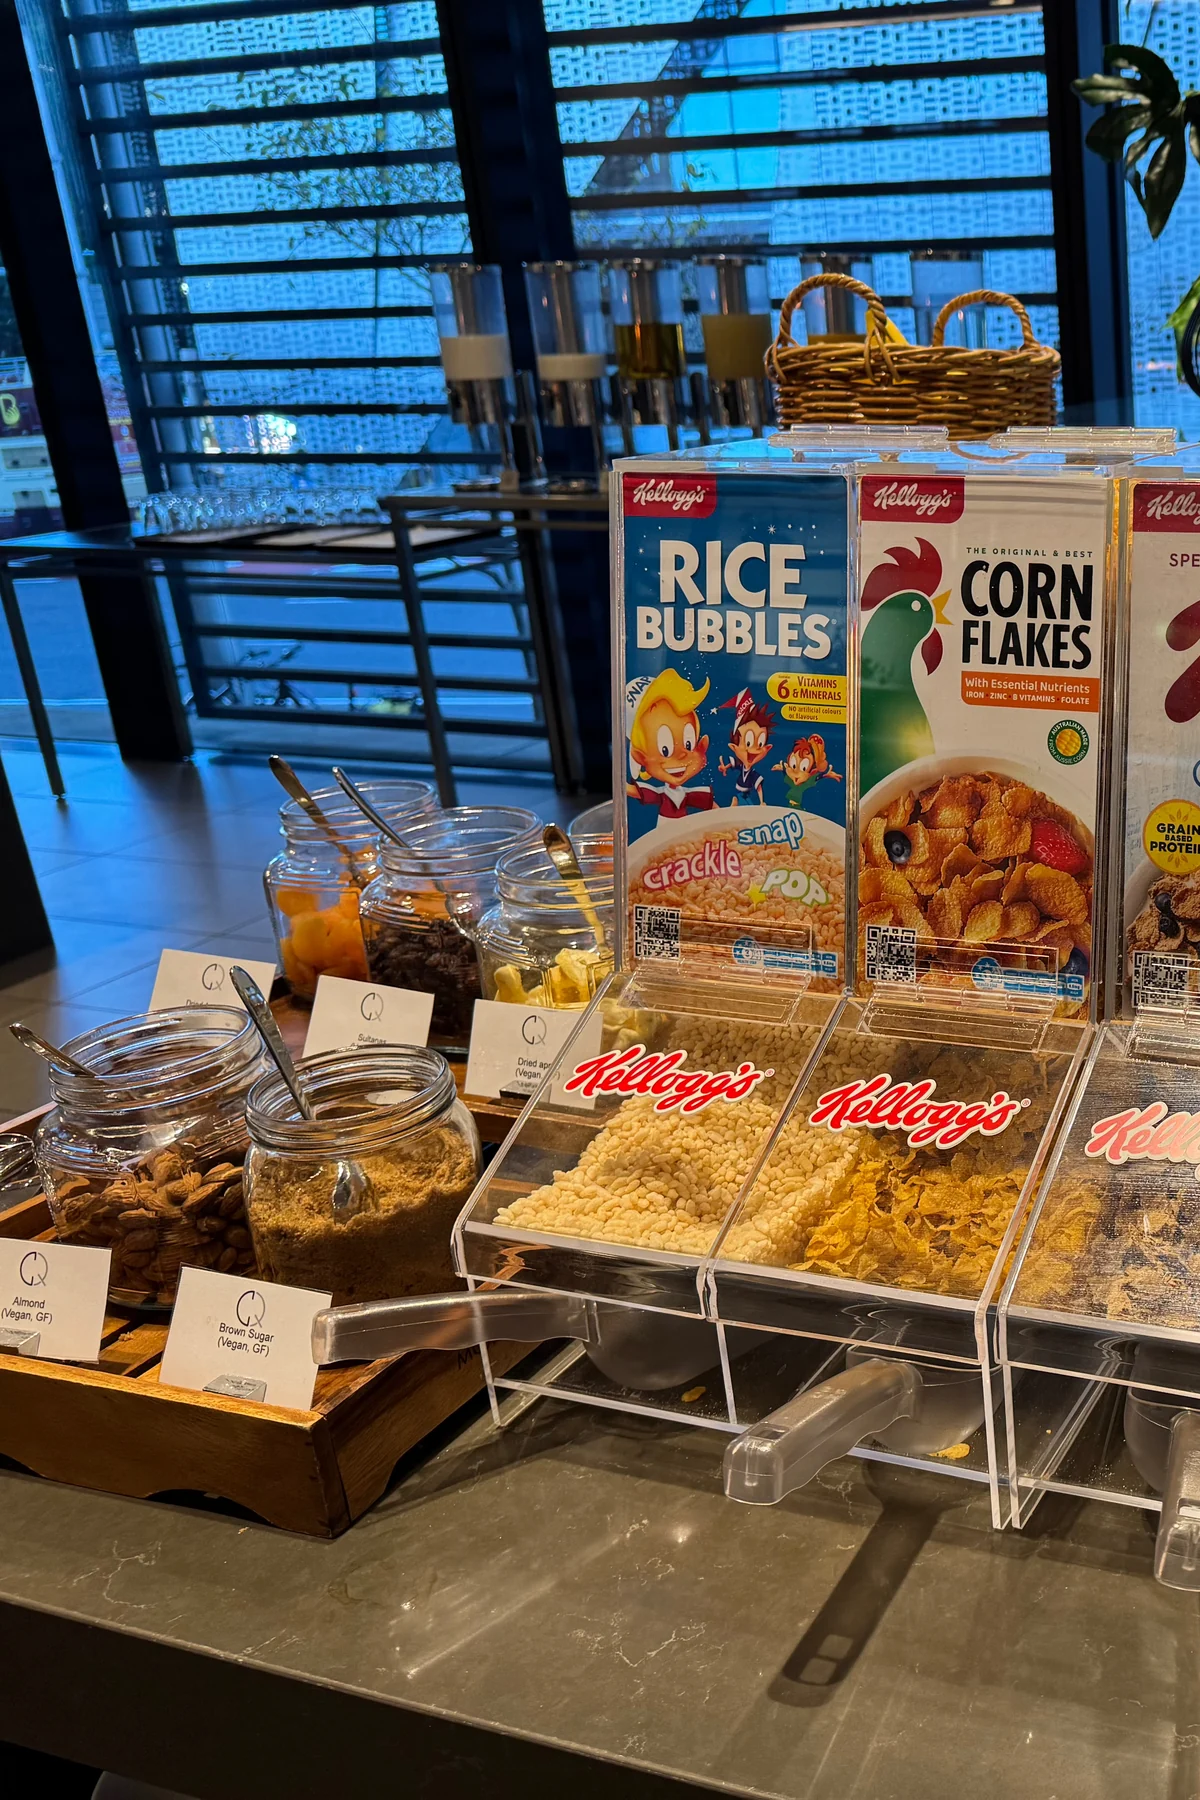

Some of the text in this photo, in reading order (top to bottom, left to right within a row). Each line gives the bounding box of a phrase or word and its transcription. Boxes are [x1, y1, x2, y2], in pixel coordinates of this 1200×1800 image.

[633, 478, 706, 511] Kellogg's
[873, 481, 953, 516] Kellogg's
[966, 546, 1093, 559] THE ORIGINAL & BEST
[659, 539, 808, 610] RICE
[960, 559, 1094, 622] CORN
[636, 606, 832, 660] BUBBLES
[962, 619, 1092, 671] FLAKES
[777, 679, 790, 699] 6
[792, 688, 799, 699] &
[965, 677, 1090, 694] With Essential Nutrients
[966, 691, 985, 699] IRON
[989, 692, 1008, 700] ZINC
[1019, 694, 1055, 703] VITAMINS
[1060, 696, 1090, 705] FOLATE
[821, 707, 842, 715] colours
[737, 811, 804, 850] snap
[1164, 834, 1193, 843] BASED
[642, 839, 742, 890] crackle
[517, 1056, 538, 1068] Dried
[564, 1046, 761, 1113] Kellogg's
[810, 1076, 1018, 1146] Kellogg's
[12, 1296, 46, 1309] Almond
[1, 1307, 53, 1325] (Vegan, GF)
[219, 1322, 275, 1343] Brown Sugar
[217, 1335, 270, 1358] (Vegan, GF)
